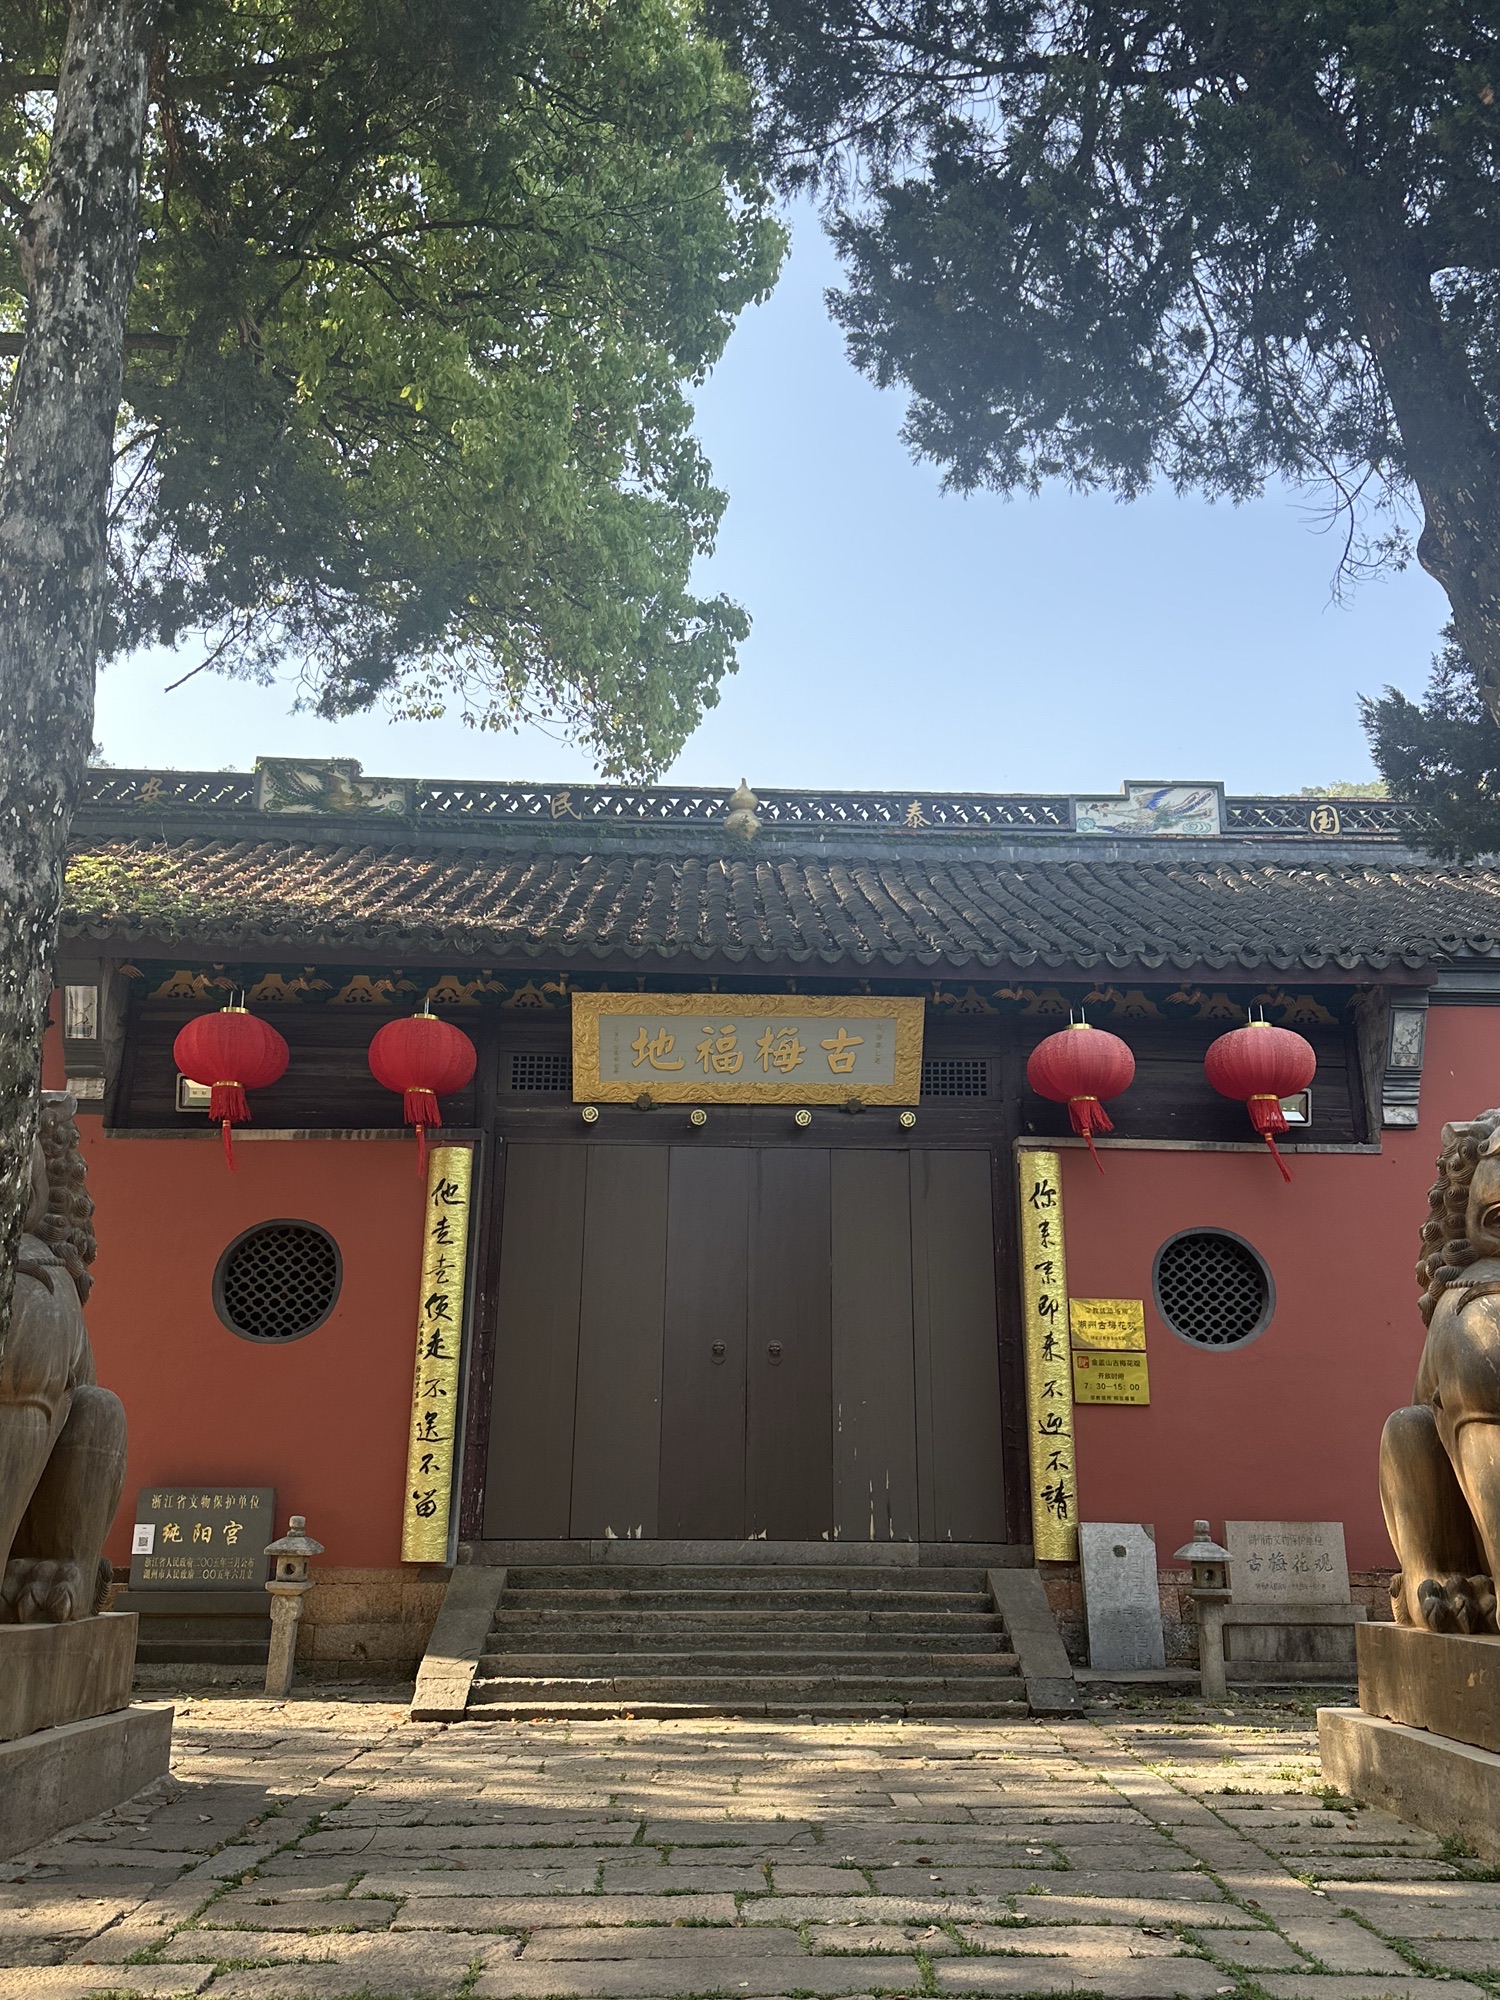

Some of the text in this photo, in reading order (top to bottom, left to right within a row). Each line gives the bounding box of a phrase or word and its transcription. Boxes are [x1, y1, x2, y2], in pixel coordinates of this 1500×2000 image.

[133, 776, 1340, 834] 国 泰 民 安
[631, 1023, 865, 1075] 古梅福地
[1097, 1372, 1125, 1380] 开放时间
[151, 1494, 260, 1510] 浙江省文物保护单位
[162, 1519, 244, 1546] 纯阳宫
[1246, 1551, 1334, 1574] 古梅花观
